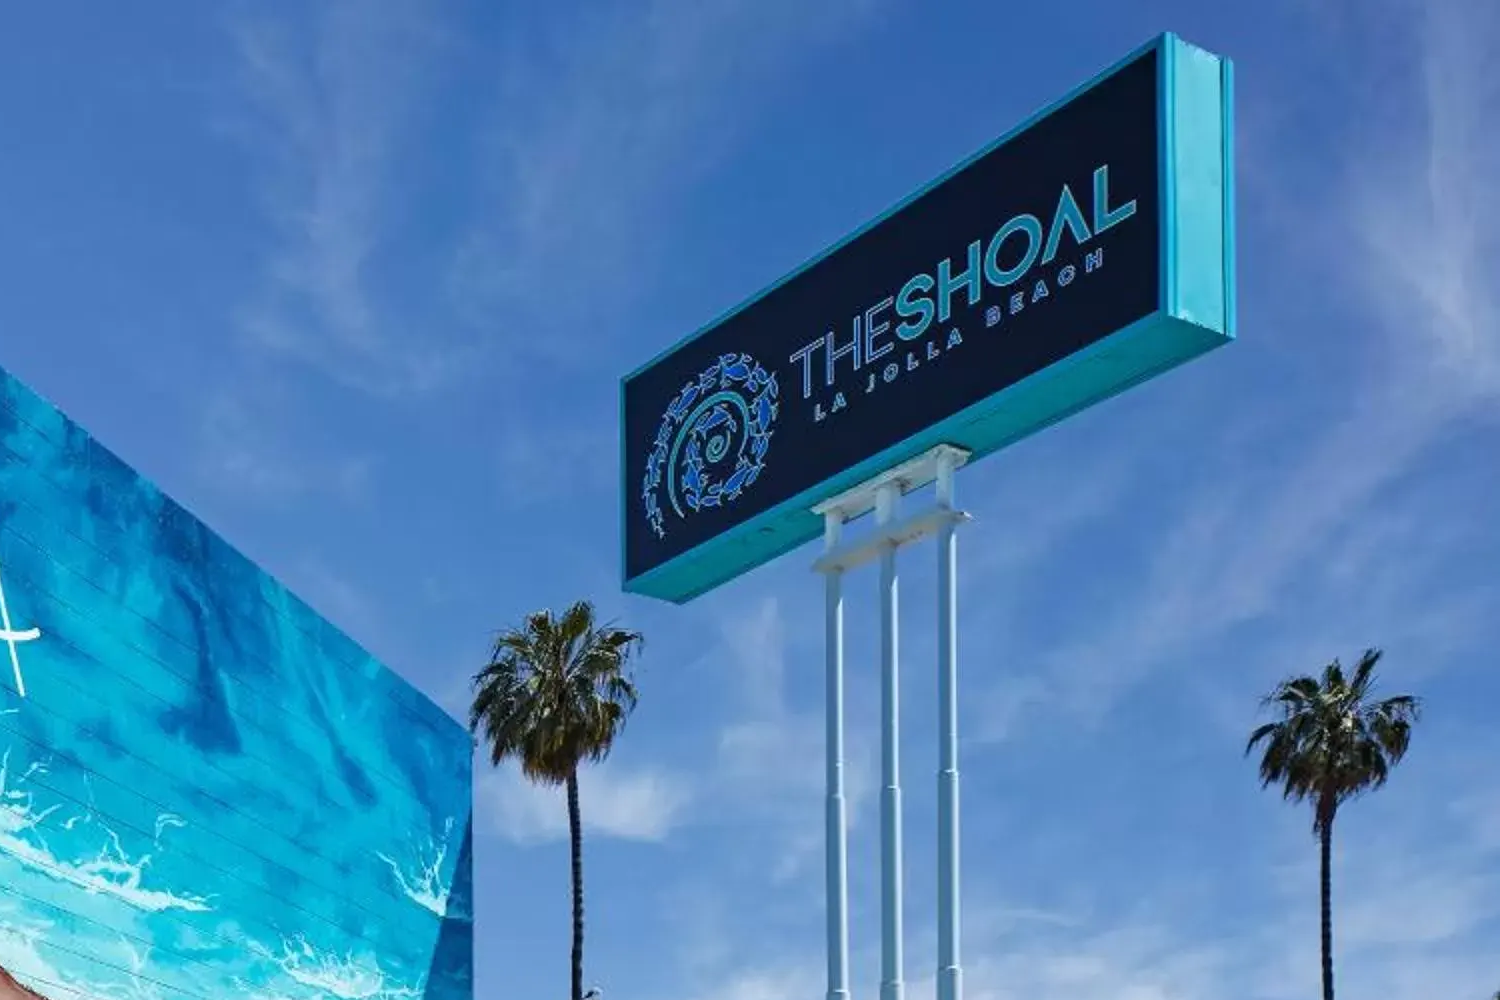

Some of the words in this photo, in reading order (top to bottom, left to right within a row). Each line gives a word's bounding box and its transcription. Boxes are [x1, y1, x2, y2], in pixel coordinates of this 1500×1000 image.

[814, 392, 847, 422] LA
[865, 327, 963, 393] JOLLA
[985, 247, 1103, 328] BEACH
